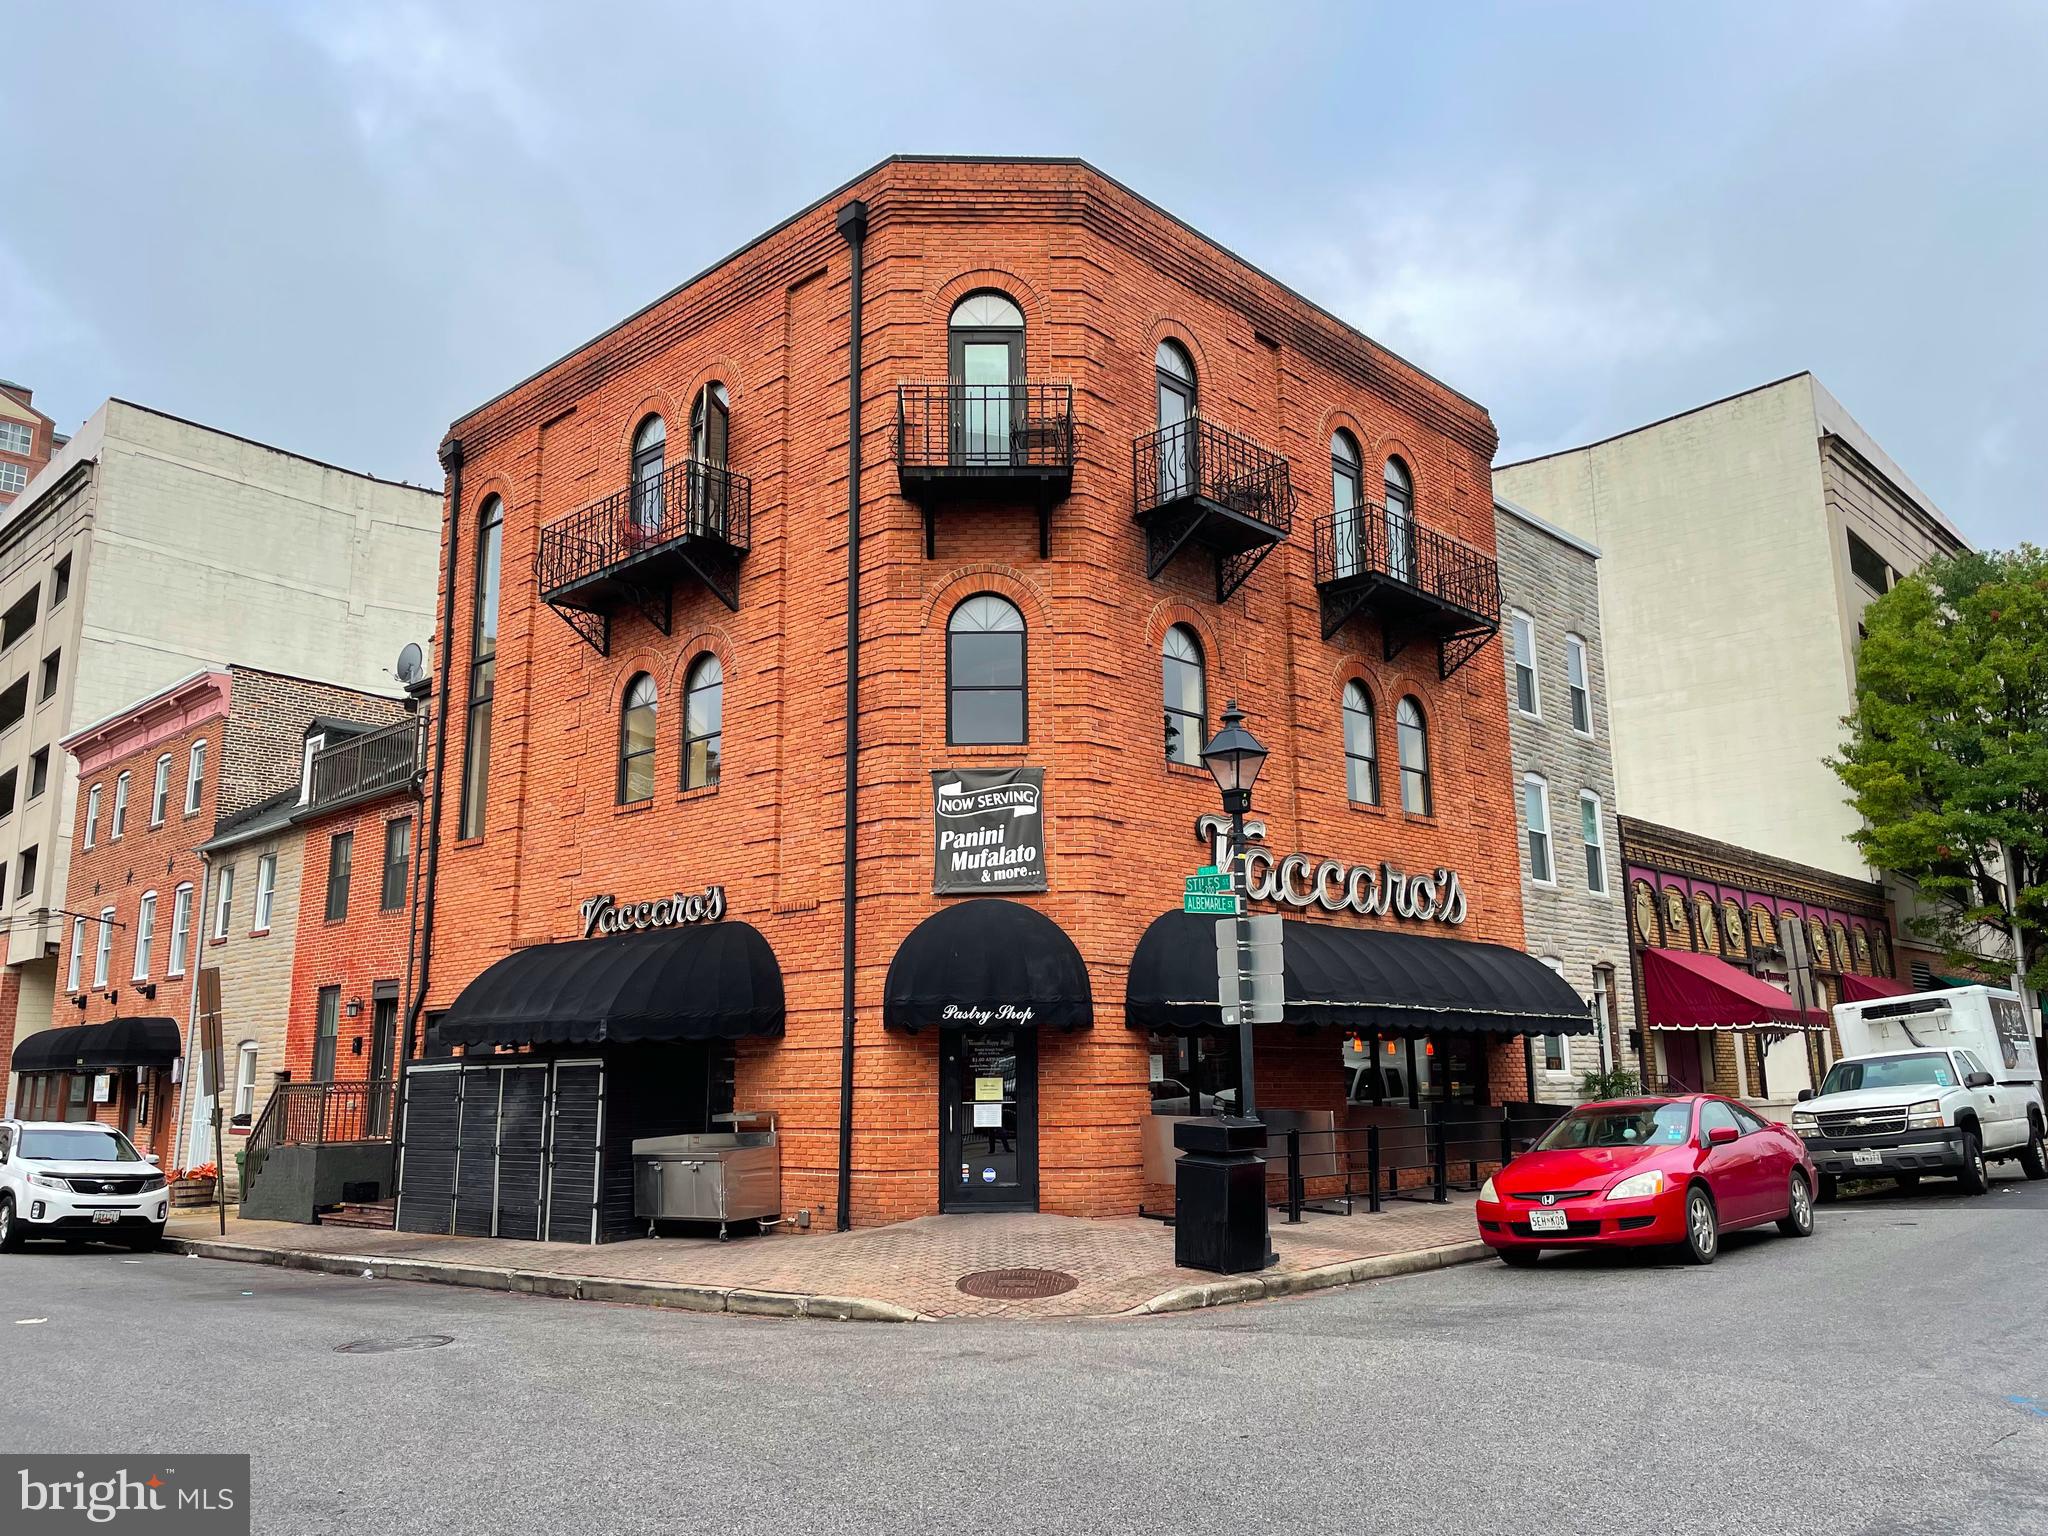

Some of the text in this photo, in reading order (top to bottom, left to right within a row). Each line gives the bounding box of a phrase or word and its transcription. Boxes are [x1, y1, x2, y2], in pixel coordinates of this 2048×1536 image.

[941, 791, 1034, 812] NOW SERVING
[940, 824, 1004, 850] Panini
[951, 844, 1036, 871] Mufalato
[1195, 813, 1468, 925] Vaccaro's
[981, 867, 1040, 883] & more...
[580, 886, 727, 938] Vaccaro's
[1188, 897, 1227, 910] ALBEMARLE
[942, 1004, 1035, 1025] Pastry Shop
